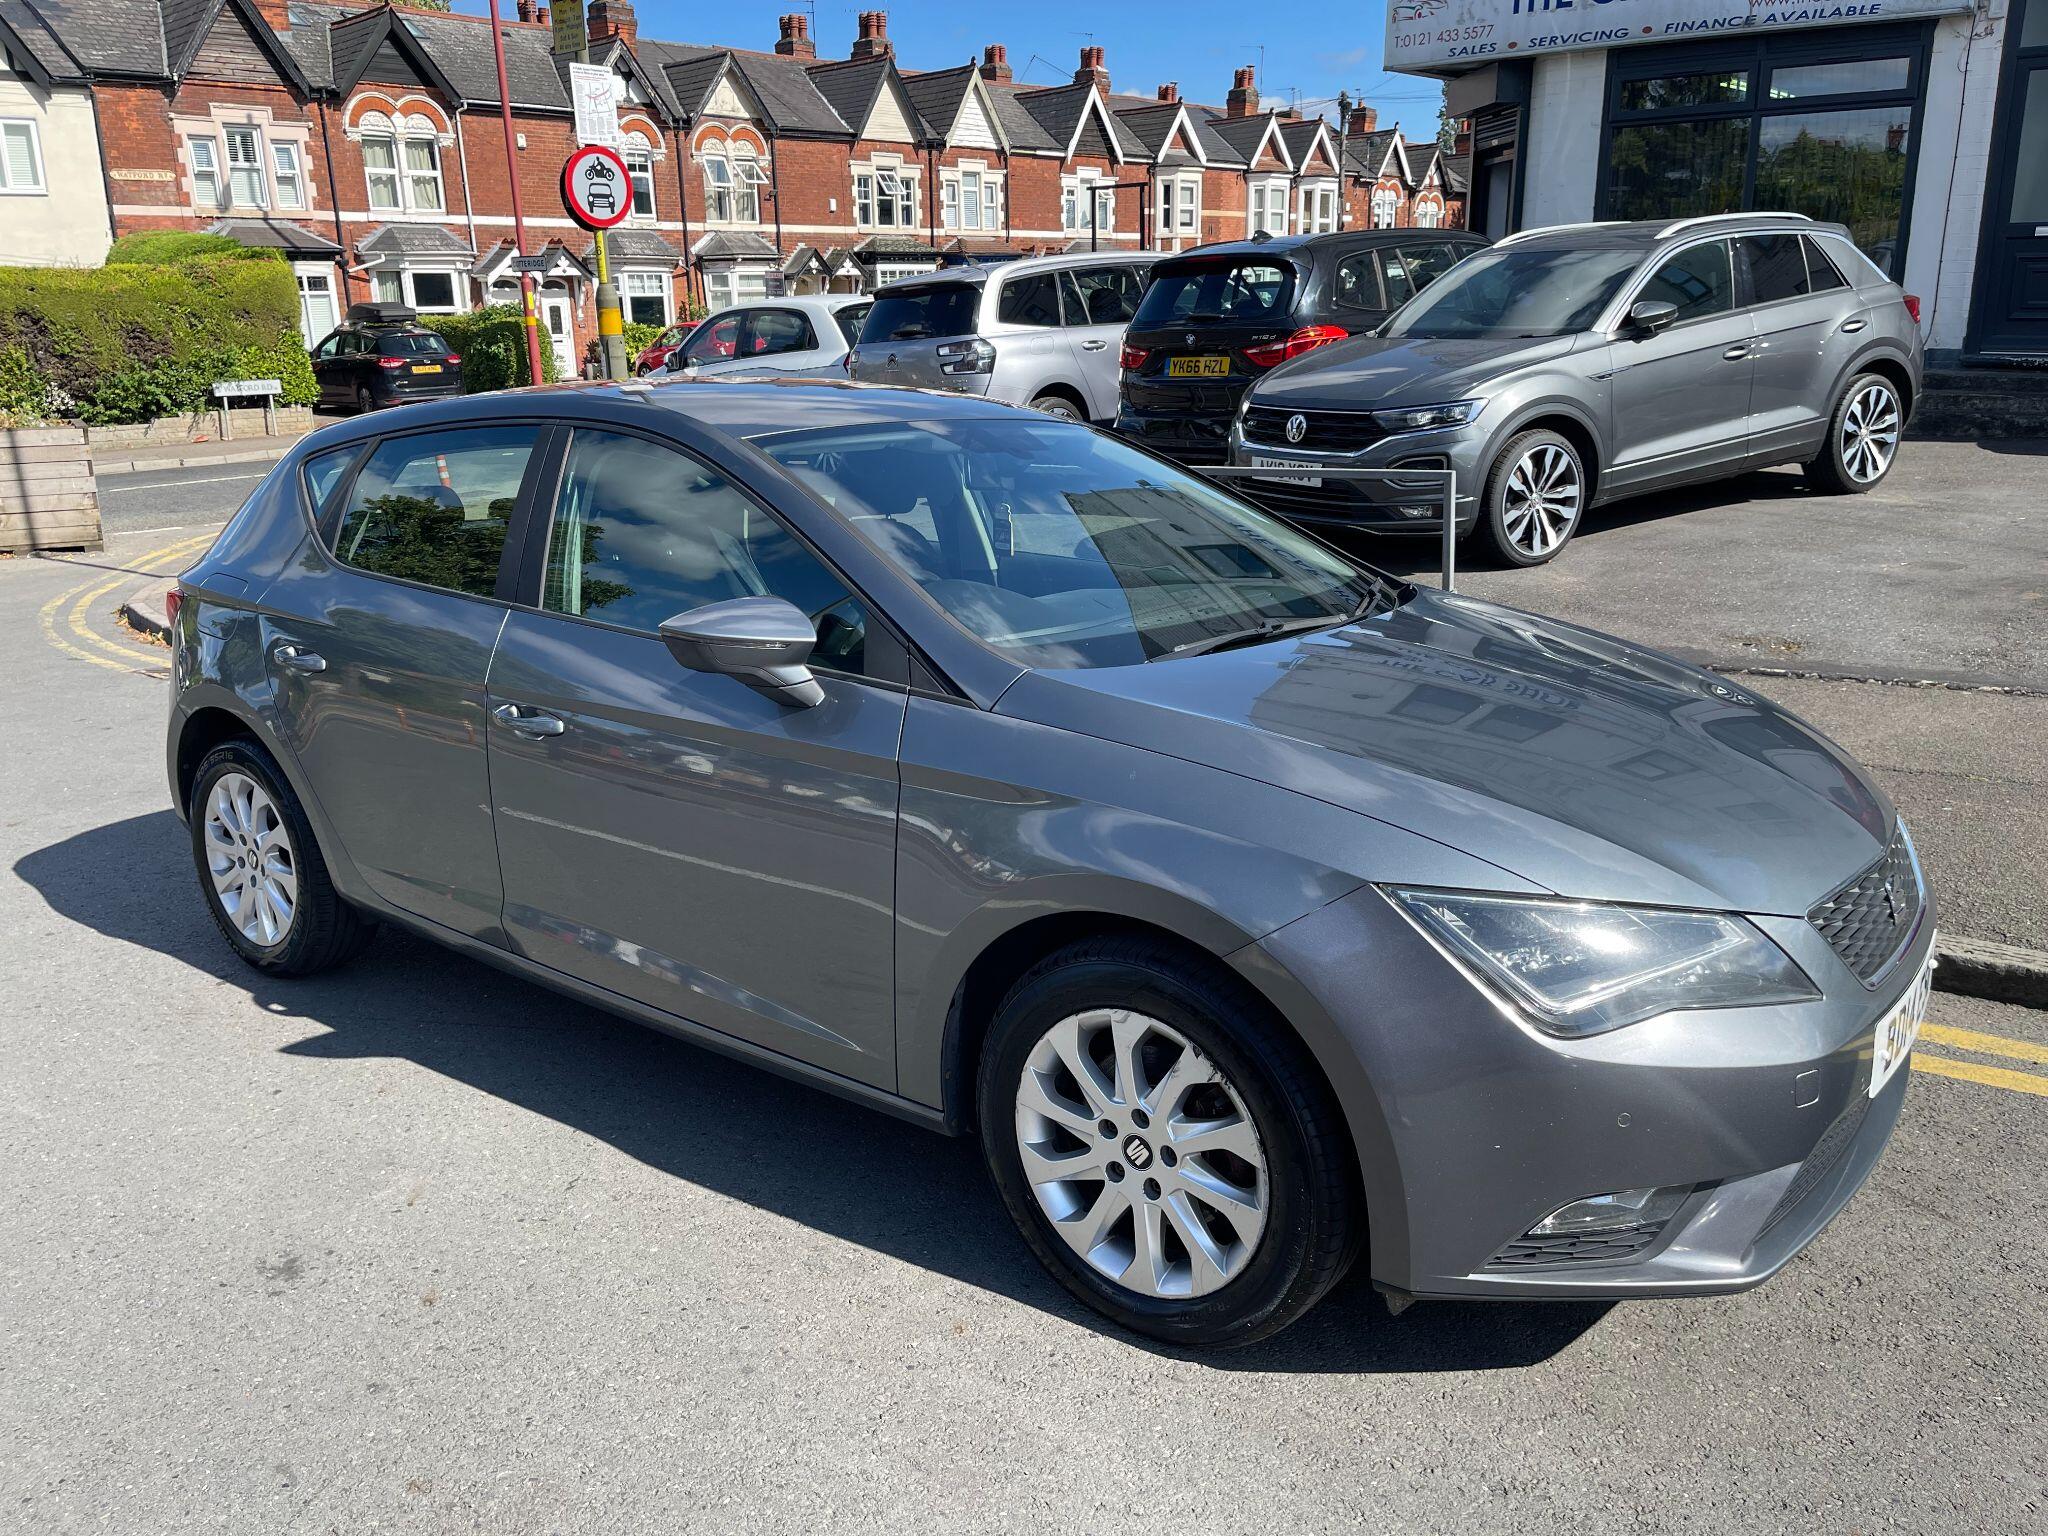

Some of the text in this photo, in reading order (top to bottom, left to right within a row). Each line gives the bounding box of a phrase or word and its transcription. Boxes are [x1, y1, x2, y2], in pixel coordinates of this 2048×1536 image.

[1395, 24, 1494, 48] T:0121 433 5577
[1448, 43, 1497, 57] SALES
[1528, 28, 1629, 48] SERVICING
[1664, 15, 1757, 33] FINANCE
[1763, 4, 1881, 24] AVAILABLE
[117, 171, 154, 179] WATFORD
[1172, 360, 1226, 374] YK66 HZL
[223, 384, 260, 393] WATFORD
